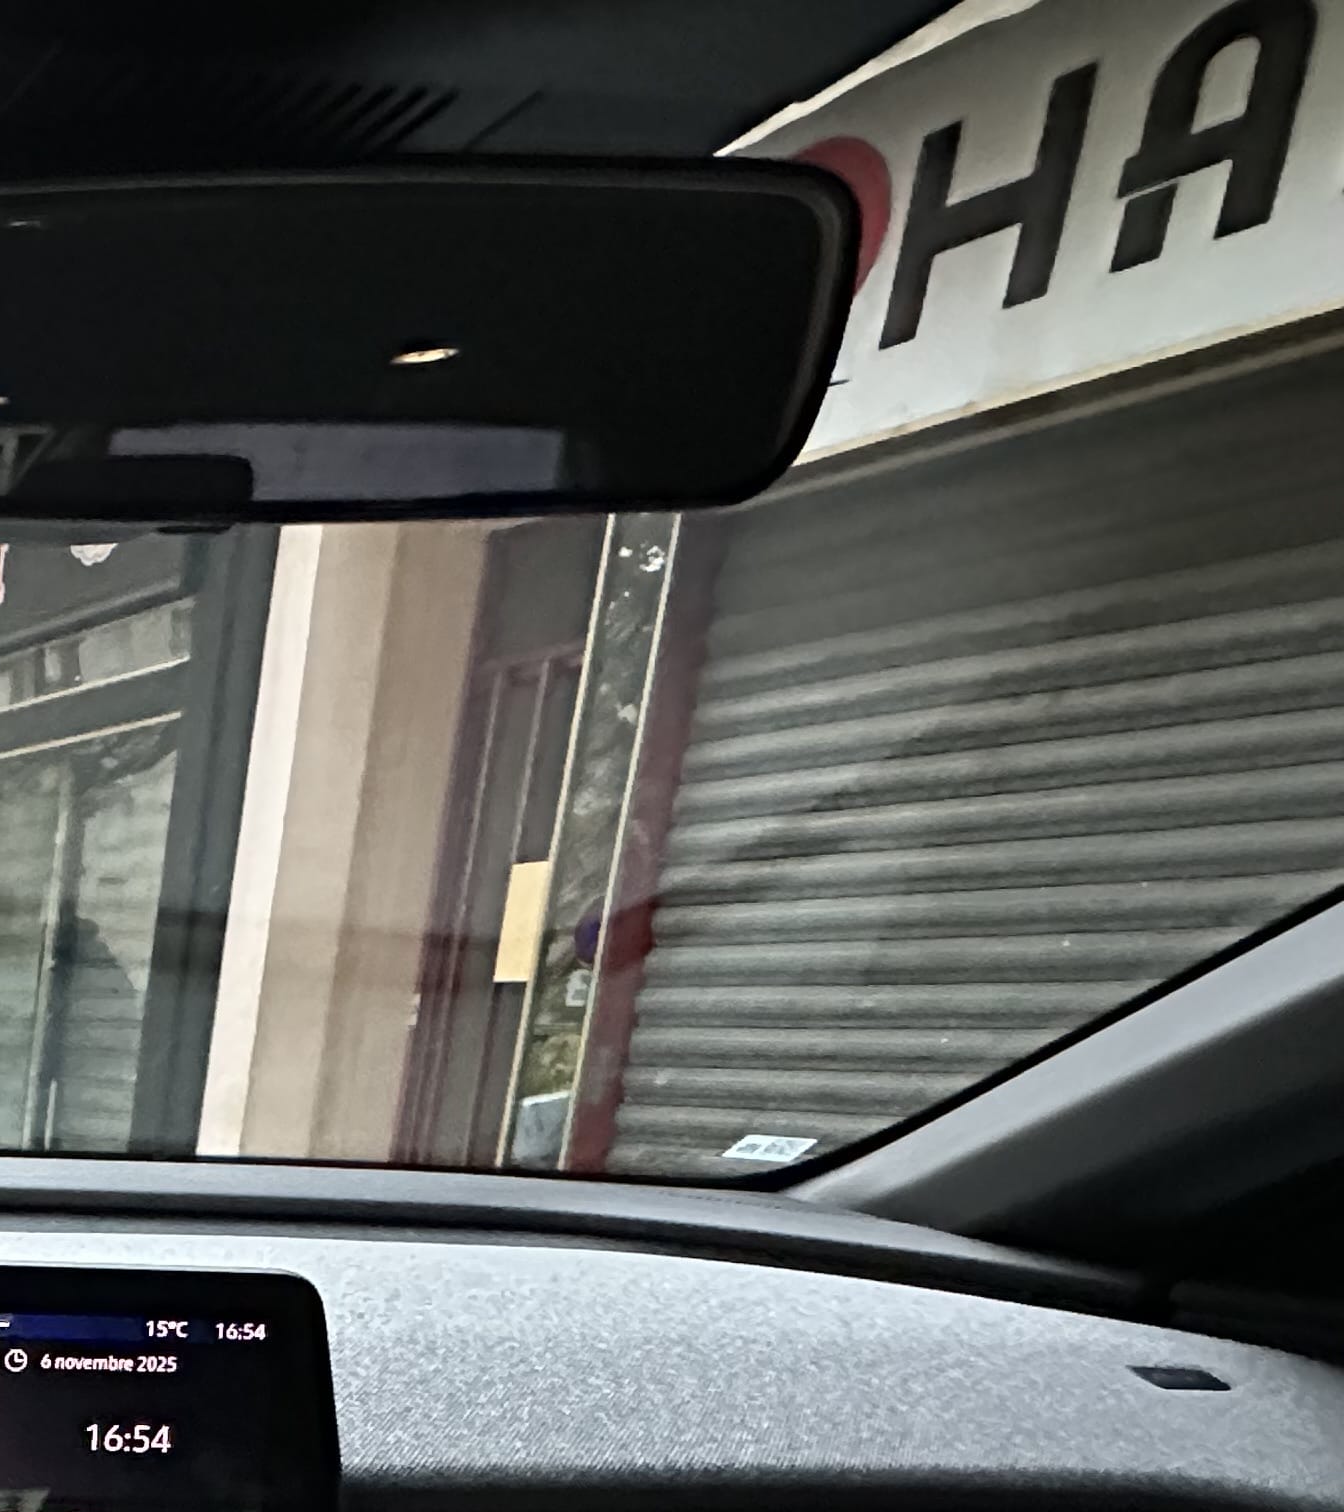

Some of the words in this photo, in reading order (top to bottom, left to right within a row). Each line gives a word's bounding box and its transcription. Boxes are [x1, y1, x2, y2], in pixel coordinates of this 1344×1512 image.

[146, 1320, 188, 1338] 15°C
[215, 1322, 266, 1340] 16:54
[40, 1354, 52, 1369] 6
[54, 1355, 134, 1372] novembre
[136, 1356, 178, 1373] 2025
[86, 1423, 172, 1453] 16:54
